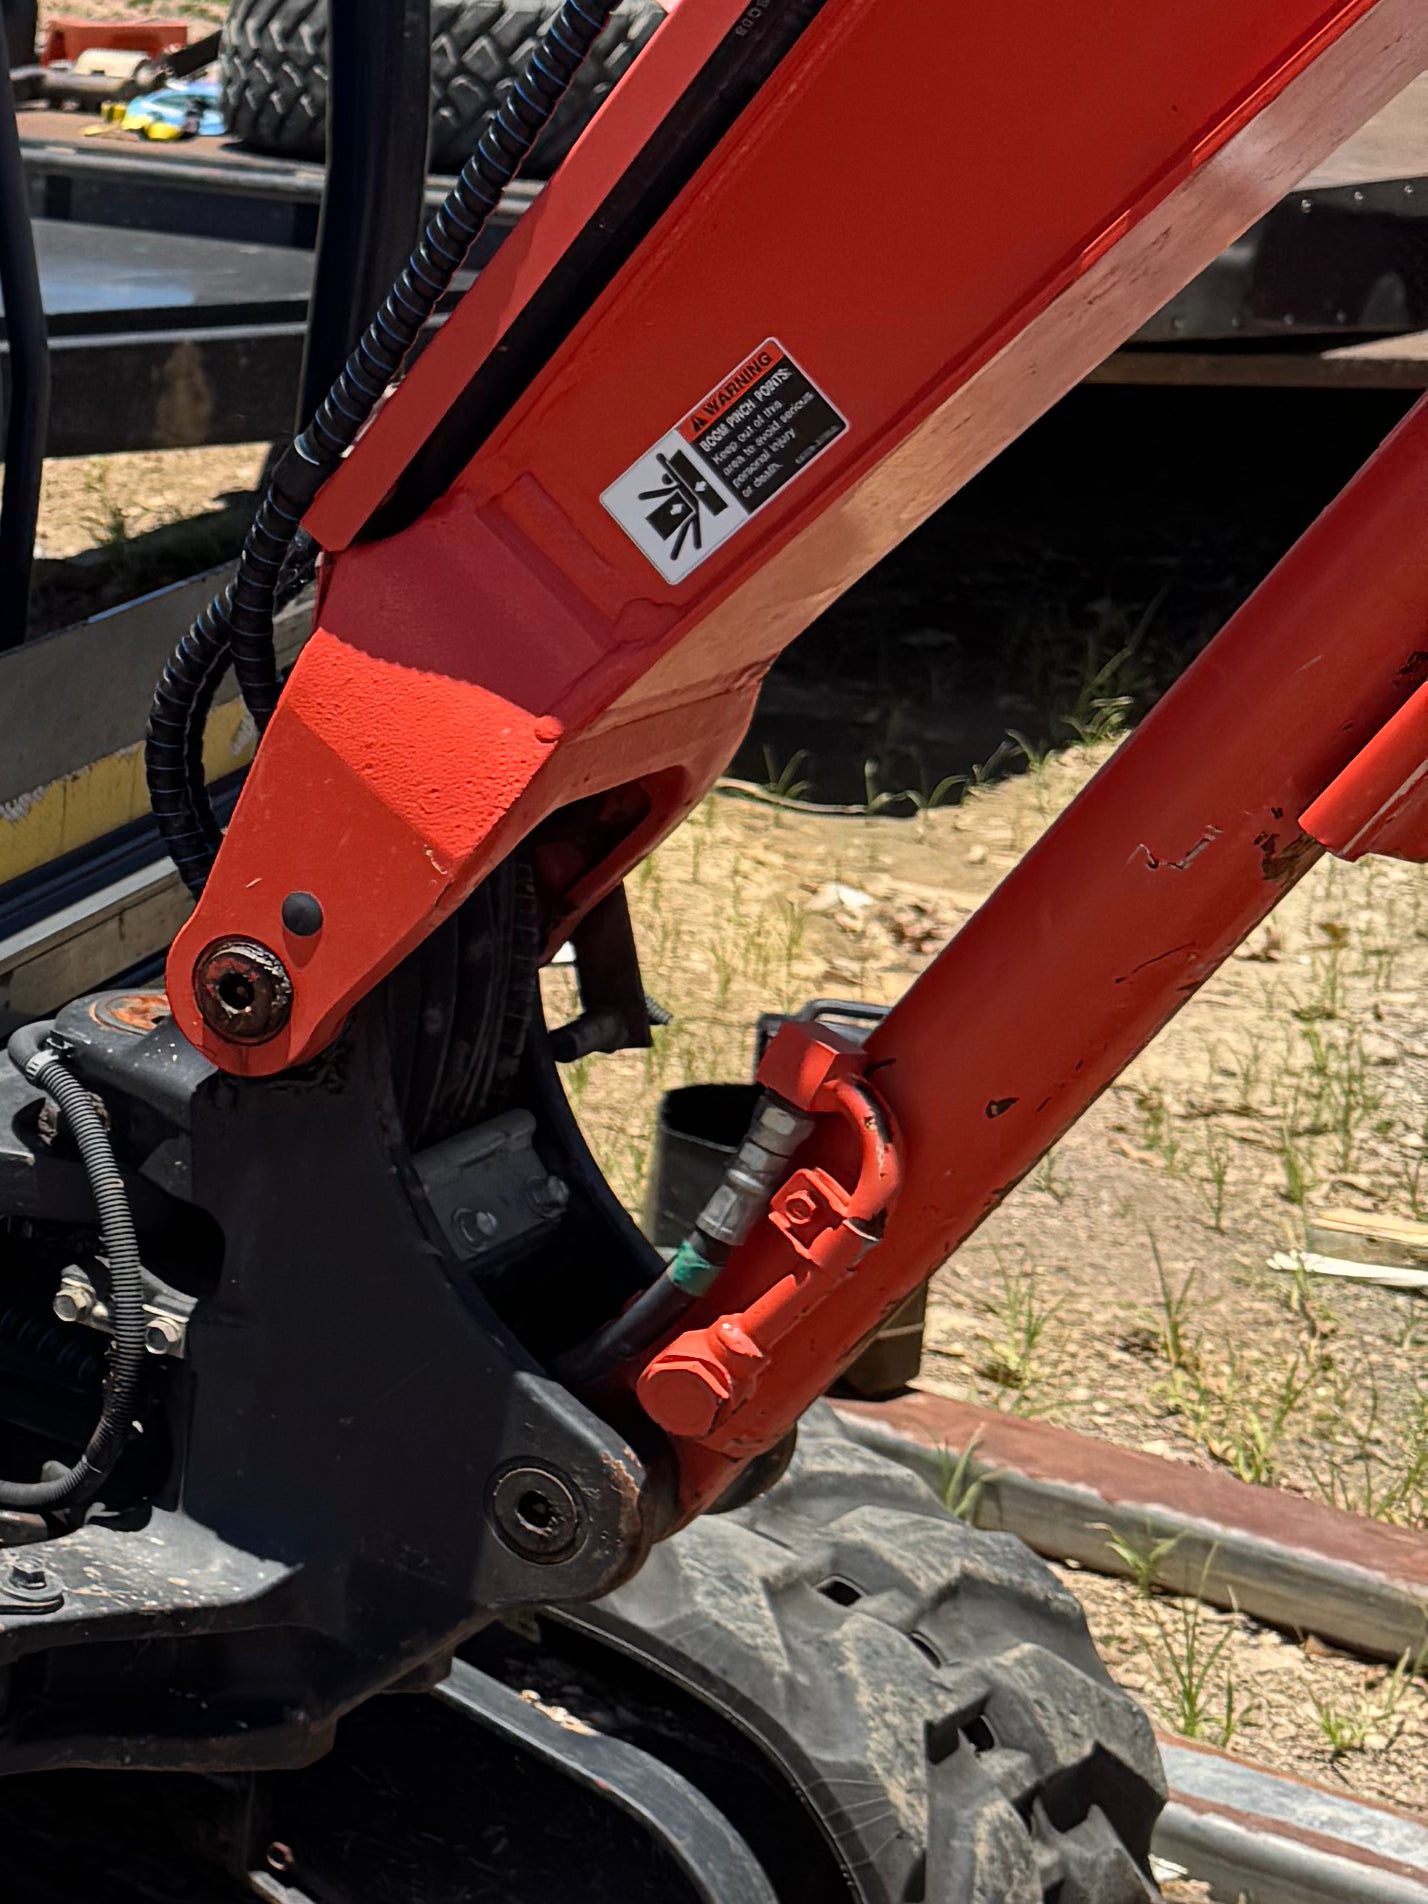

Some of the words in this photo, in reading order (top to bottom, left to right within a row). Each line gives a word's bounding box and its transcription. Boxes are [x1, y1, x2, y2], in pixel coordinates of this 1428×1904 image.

[703, 351, 773, 416] WARNING
[726, 399, 756, 428] PINCH
[712, 441, 738, 465] Keep
[737, 425, 754, 443] out
[722, 455, 745, 476] area
[755, 421, 781, 447] avoid
[732, 450, 771, 489] personal
[769, 428, 797, 452] injury
